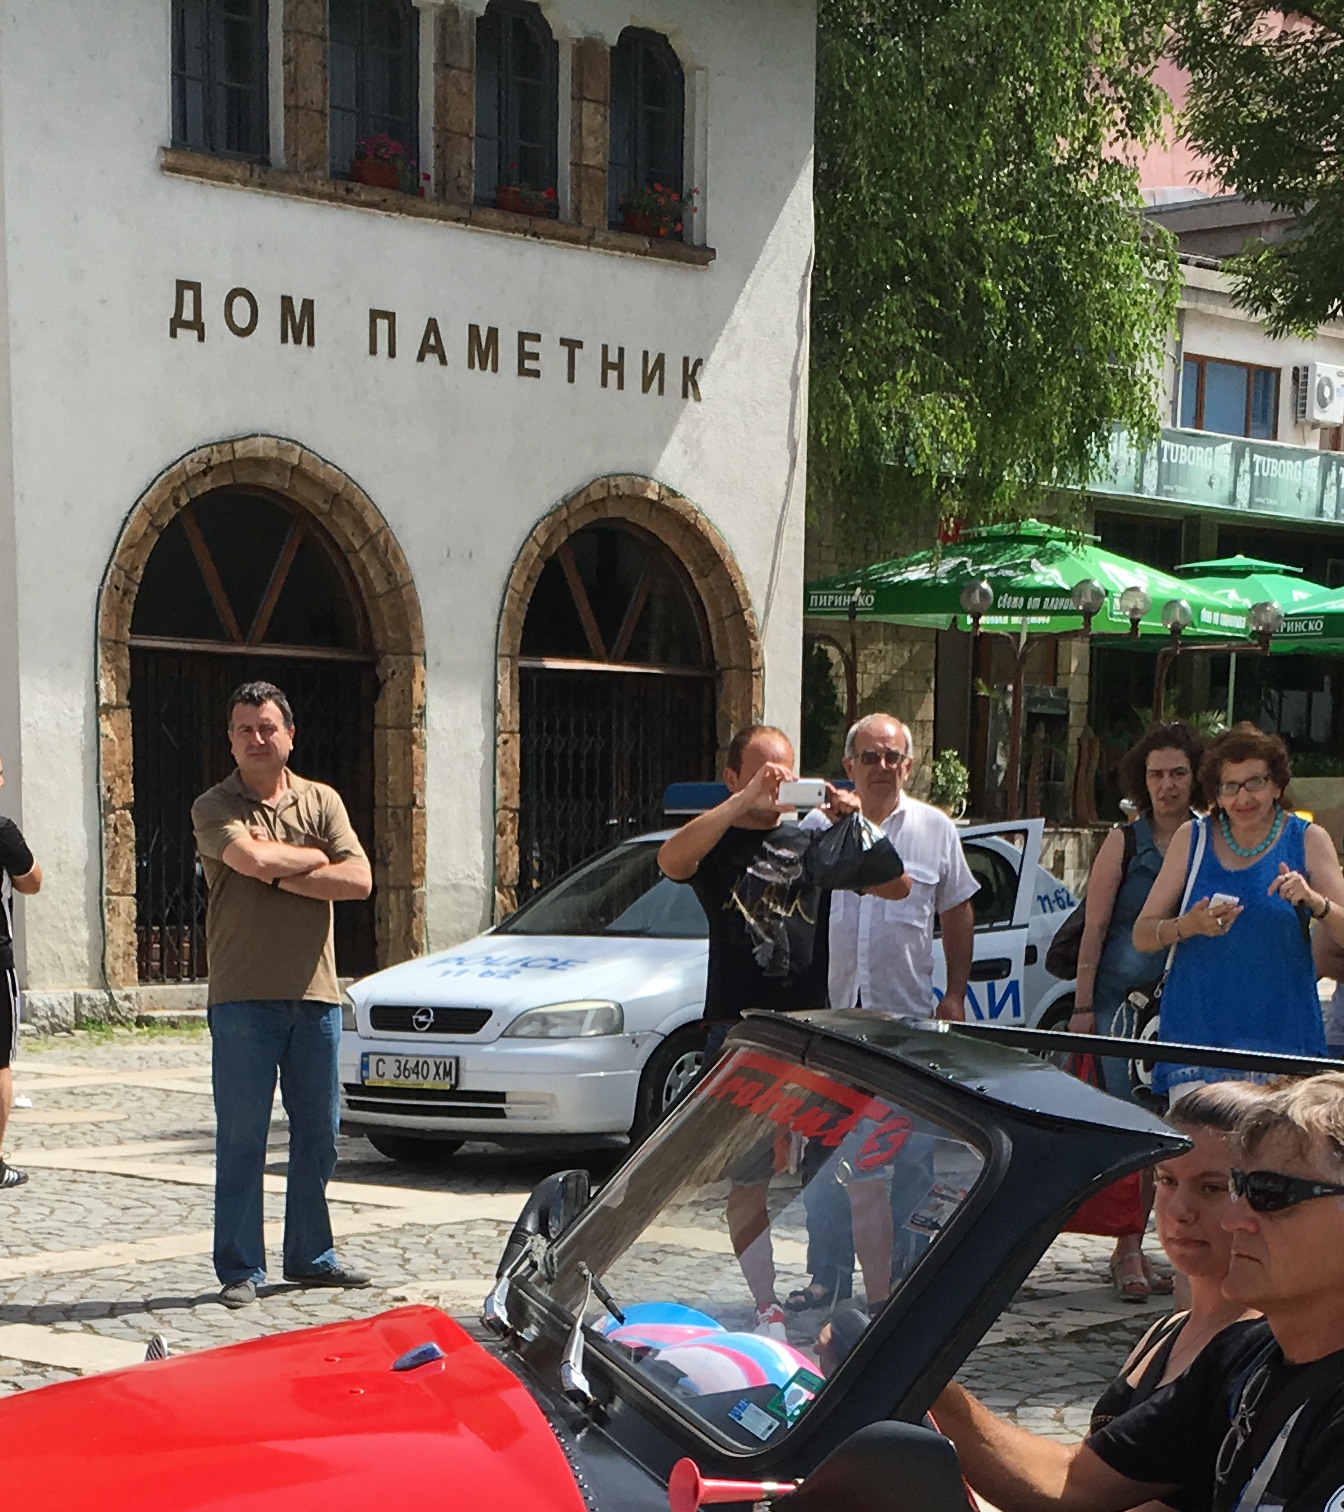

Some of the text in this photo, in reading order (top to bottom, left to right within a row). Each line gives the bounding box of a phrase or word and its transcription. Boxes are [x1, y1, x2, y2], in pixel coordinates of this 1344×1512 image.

[169, 278, 704, 401] ДОМ ПАМЕТНИК
[1160, 440, 1213, 469] TUBORG
[1253, 454, 1303, 483] TUBORG
[428, 955, 588, 972] POLICE
[393, 1058, 430, 1081] 3640
